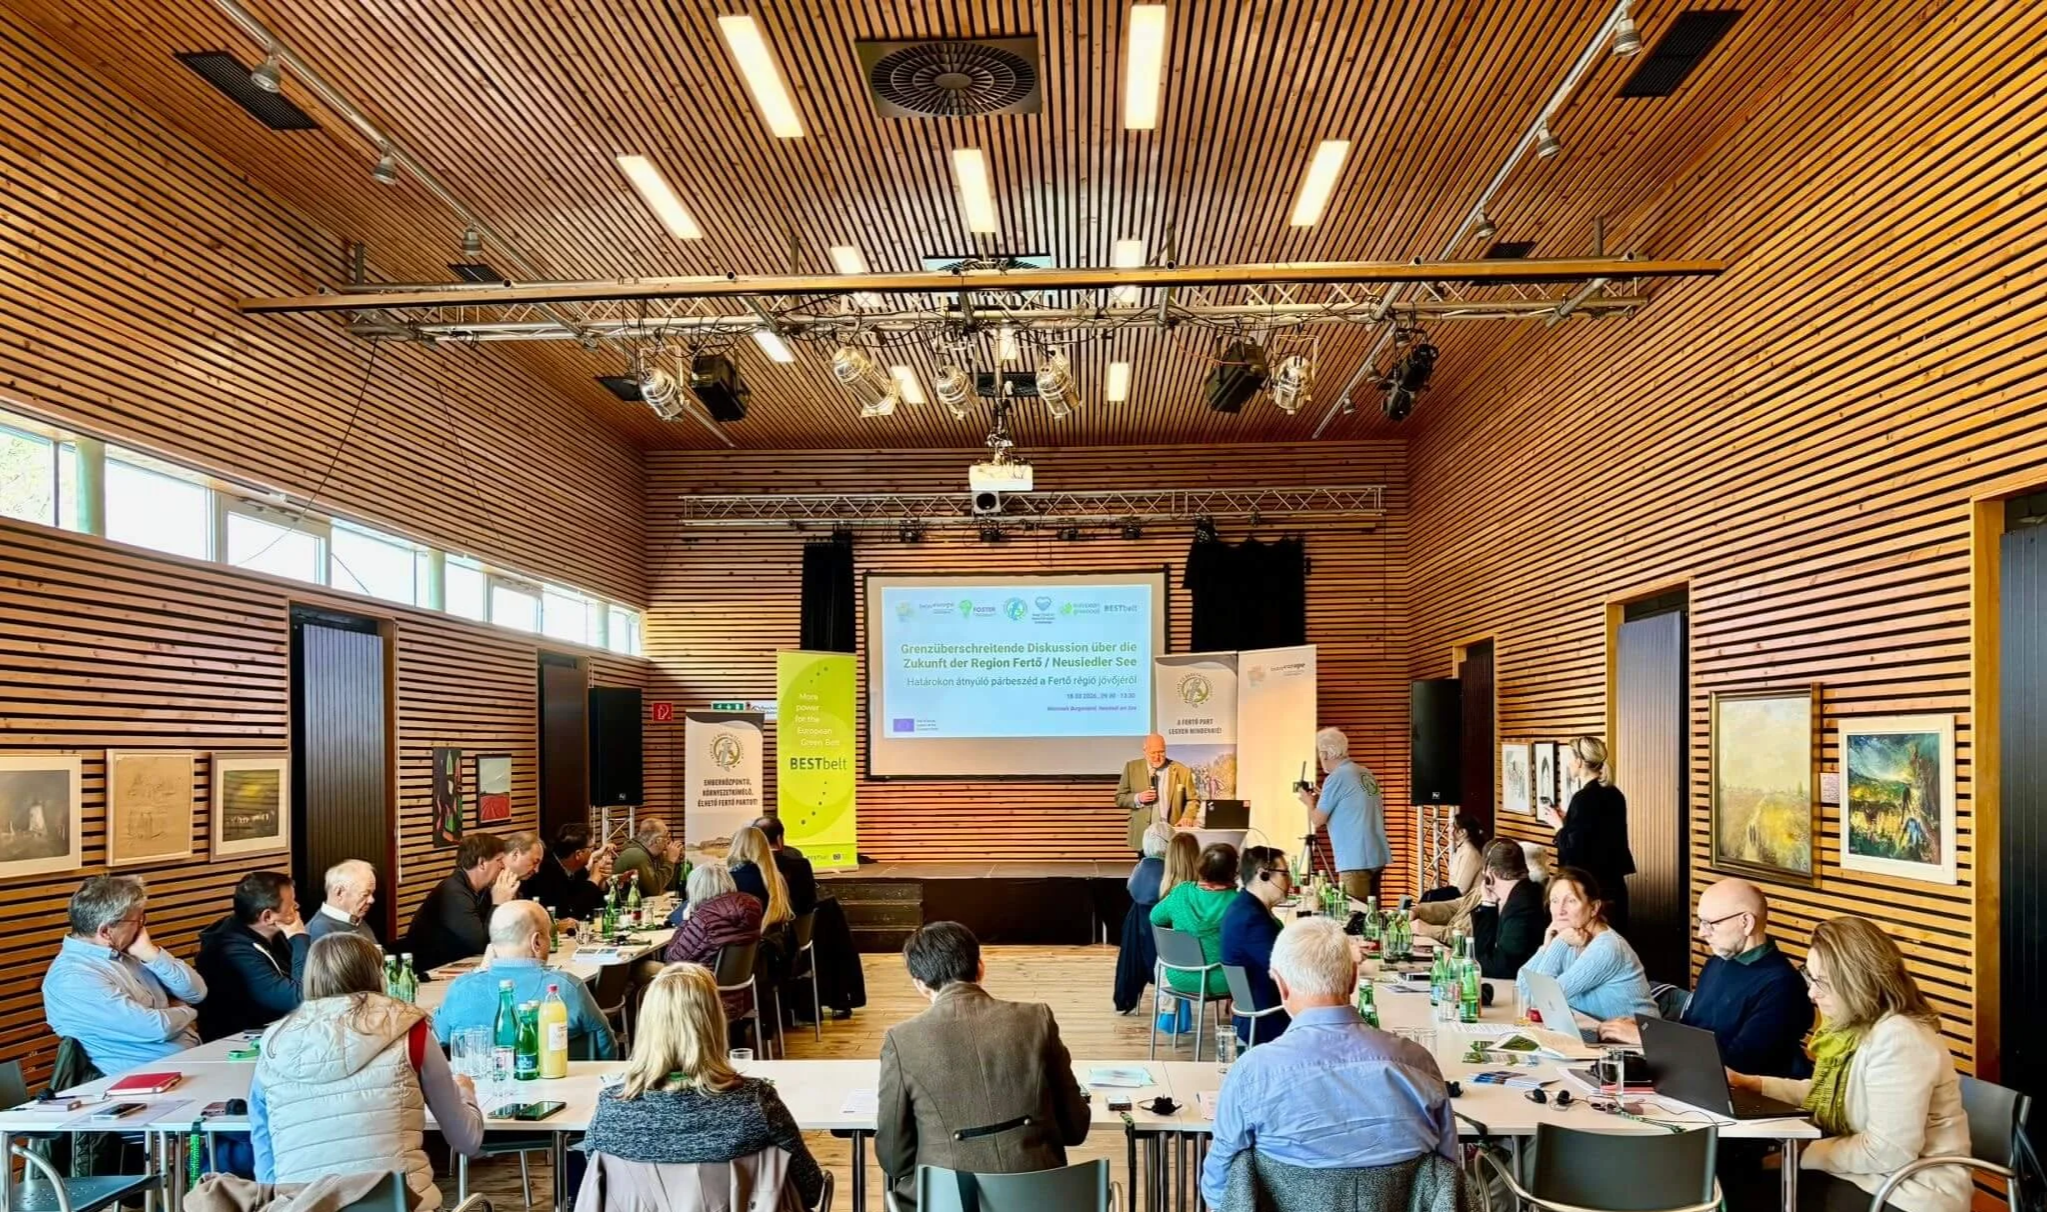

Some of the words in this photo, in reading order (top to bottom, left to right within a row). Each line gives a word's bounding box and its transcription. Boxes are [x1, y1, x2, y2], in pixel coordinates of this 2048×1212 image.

[1104, 604, 1138, 612] BESTbelt
[900, 642, 1025, 655] Grenzüberschreitende
[1027, 642, 1088, 653] Diskussion
[1091, 641, 1117, 653] über
[1119, 641, 1138, 652] die
[903, 657, 947, 668] Zukunft
[949, 657, 969, 668] der
[971, 657, 1010, 670] Region
[1013, 656, 1042, 667] Fertő
[1052, 656, 1113, 667] Neusiedler
[1115, 656, 1138, 666] See
[907, 676, 954, 686] Határokon
[991, 675, 1038, 688] párbeszéd
[795, 704, 820, 713] power
[794, 715, 806, 723] for
[807, 715, 820, 723] the
[798, 727, 832, 735] European
[800, 738, 823, 746] Green
[790, 757, 847, 769] BESTbelt
